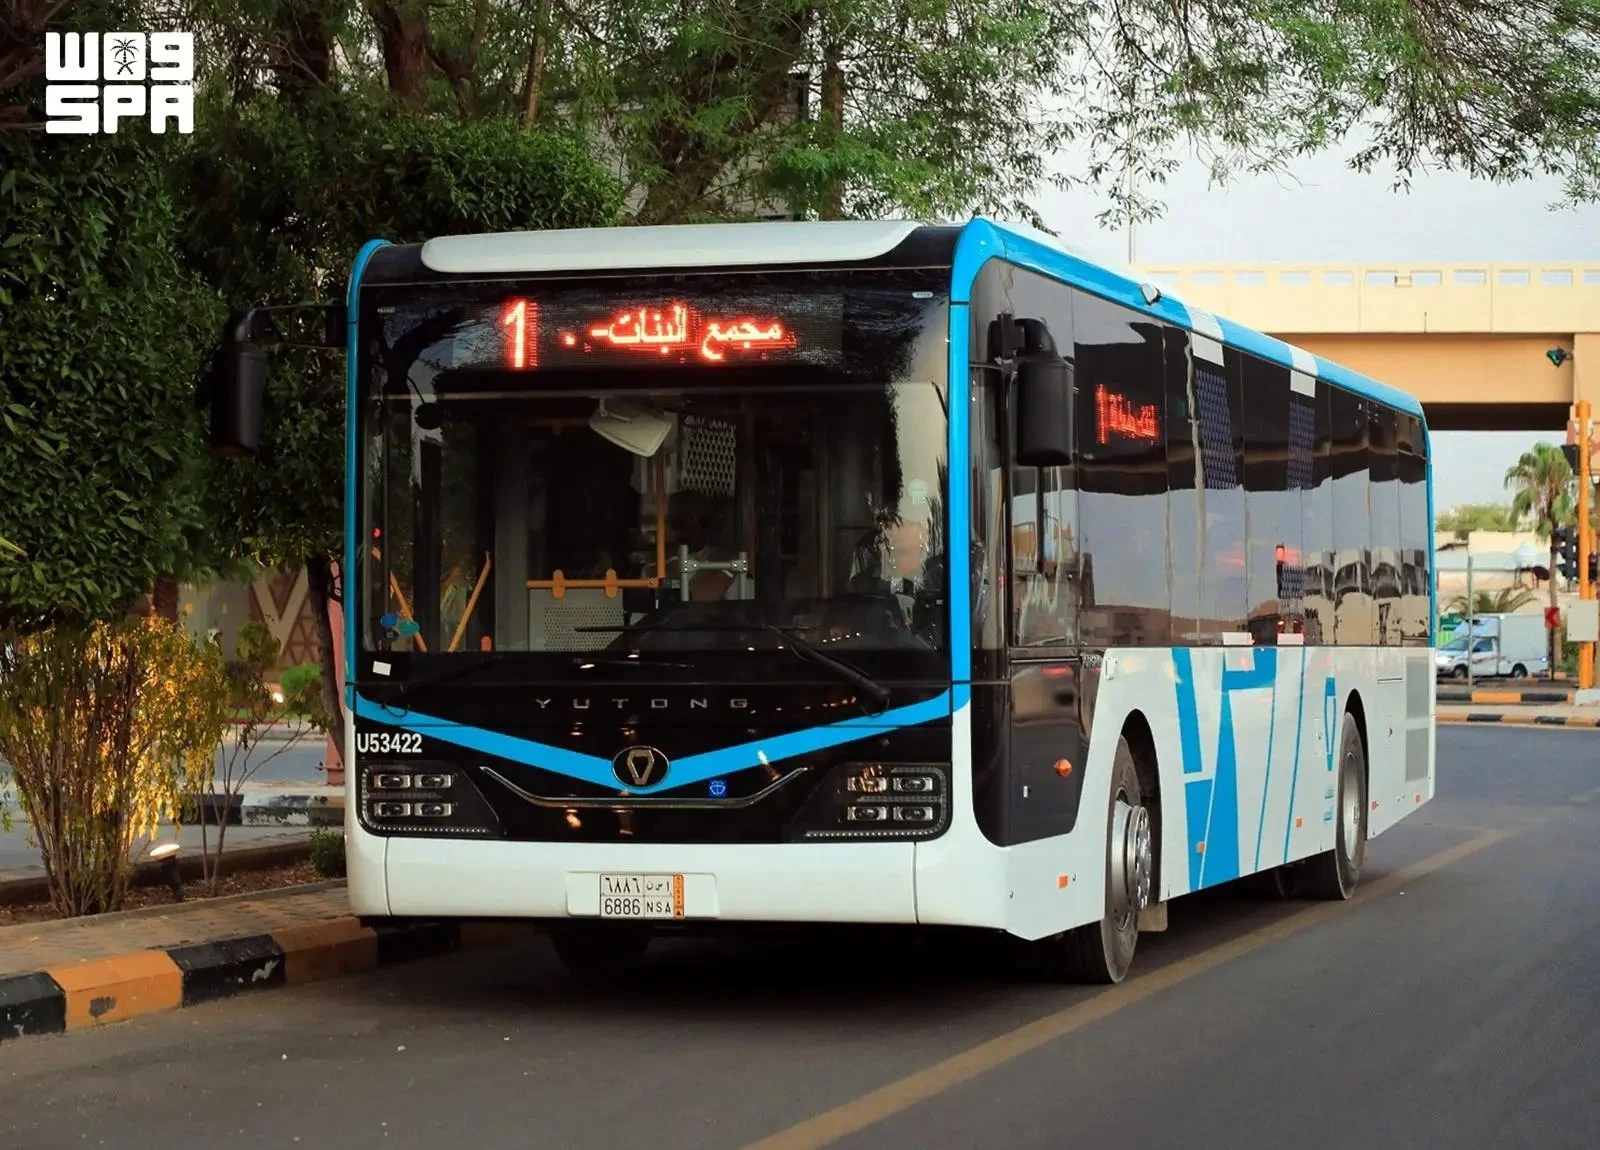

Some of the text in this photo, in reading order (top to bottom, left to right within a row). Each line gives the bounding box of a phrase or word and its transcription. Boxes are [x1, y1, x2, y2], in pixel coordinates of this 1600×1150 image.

[504, 300, 530, 368] 1
[701, 320, 783, 360] مجمع
[536, 698, 748, 709] YUTONG
[356, 733, 423, 753] U53422
[605, 877, 640, 893] ٦٨٨٦
[604, 898, 640, 915] 6886
[646, 901, 671, 913] NSA
